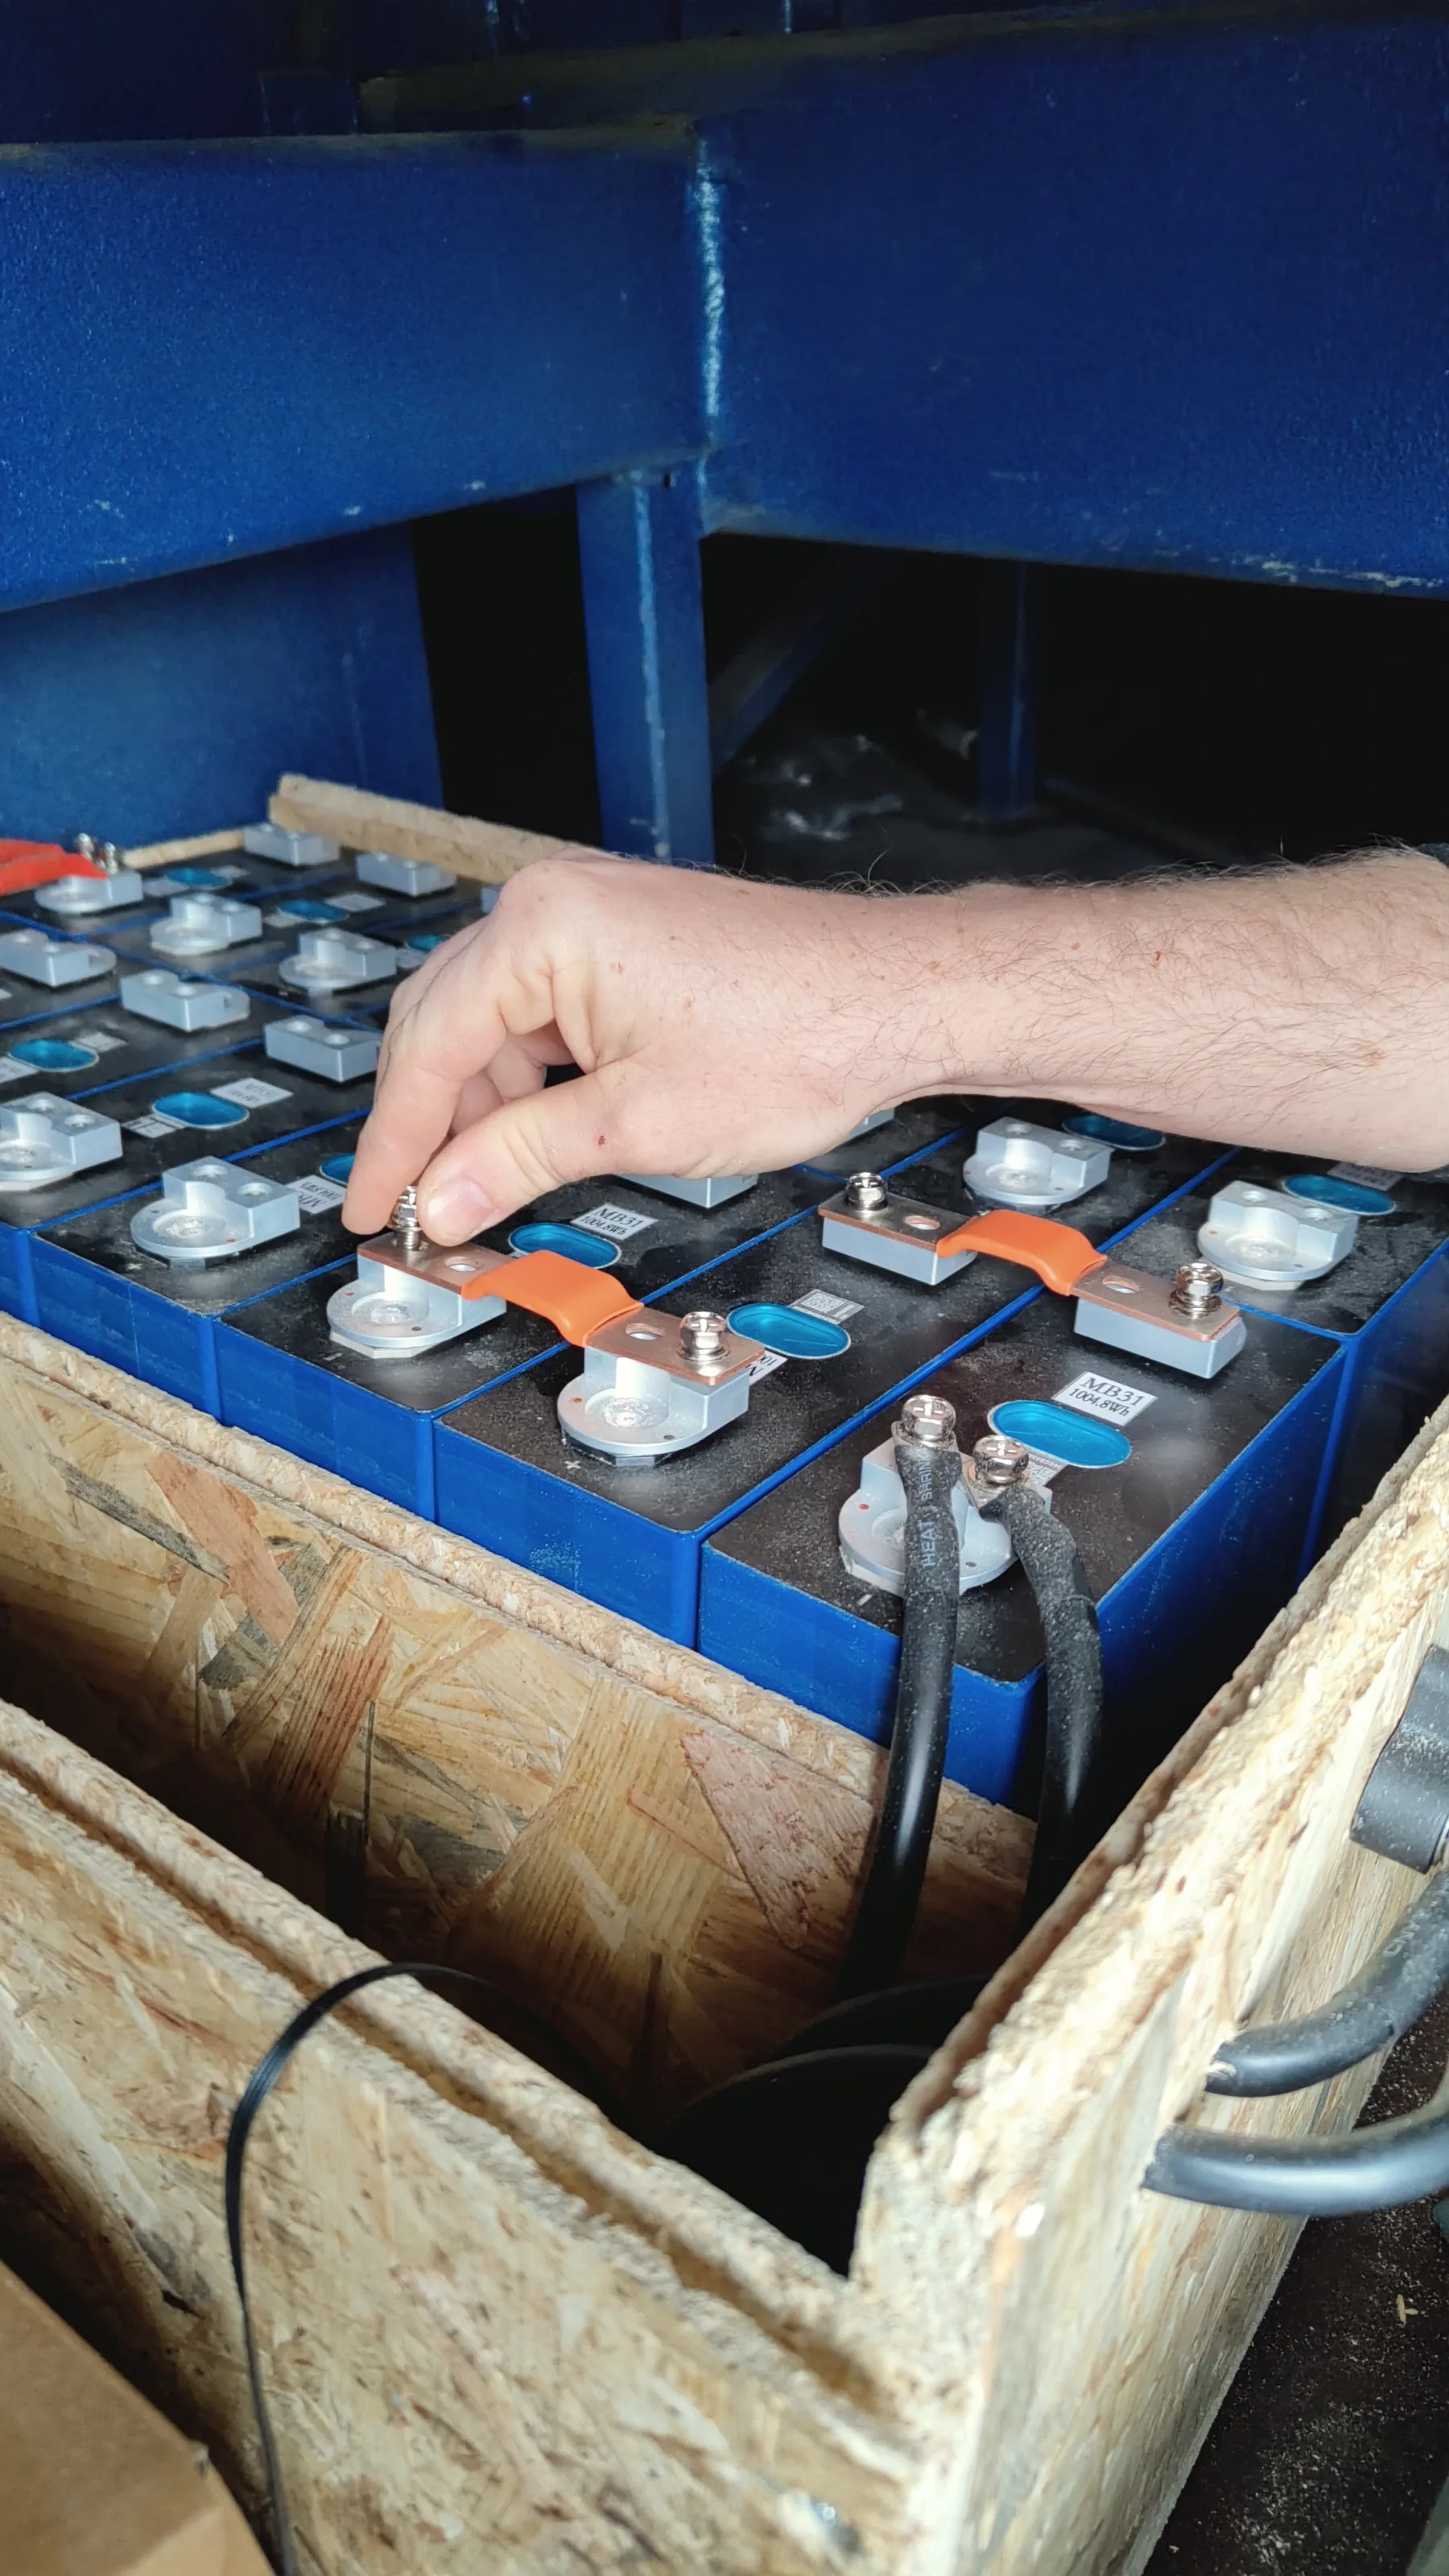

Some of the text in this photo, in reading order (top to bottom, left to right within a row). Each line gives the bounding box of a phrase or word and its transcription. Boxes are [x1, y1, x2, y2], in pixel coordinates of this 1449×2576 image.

[580, 1216, 628, 1236] 1004.8Wh
[594, 1208, 644, 1228] MB31
[1069, 1388, 1130, 1417] 1004.8Wh
[1080, 1377, 1145, 1407] MB31
[917, 1518, 936, 1569] HEAT
